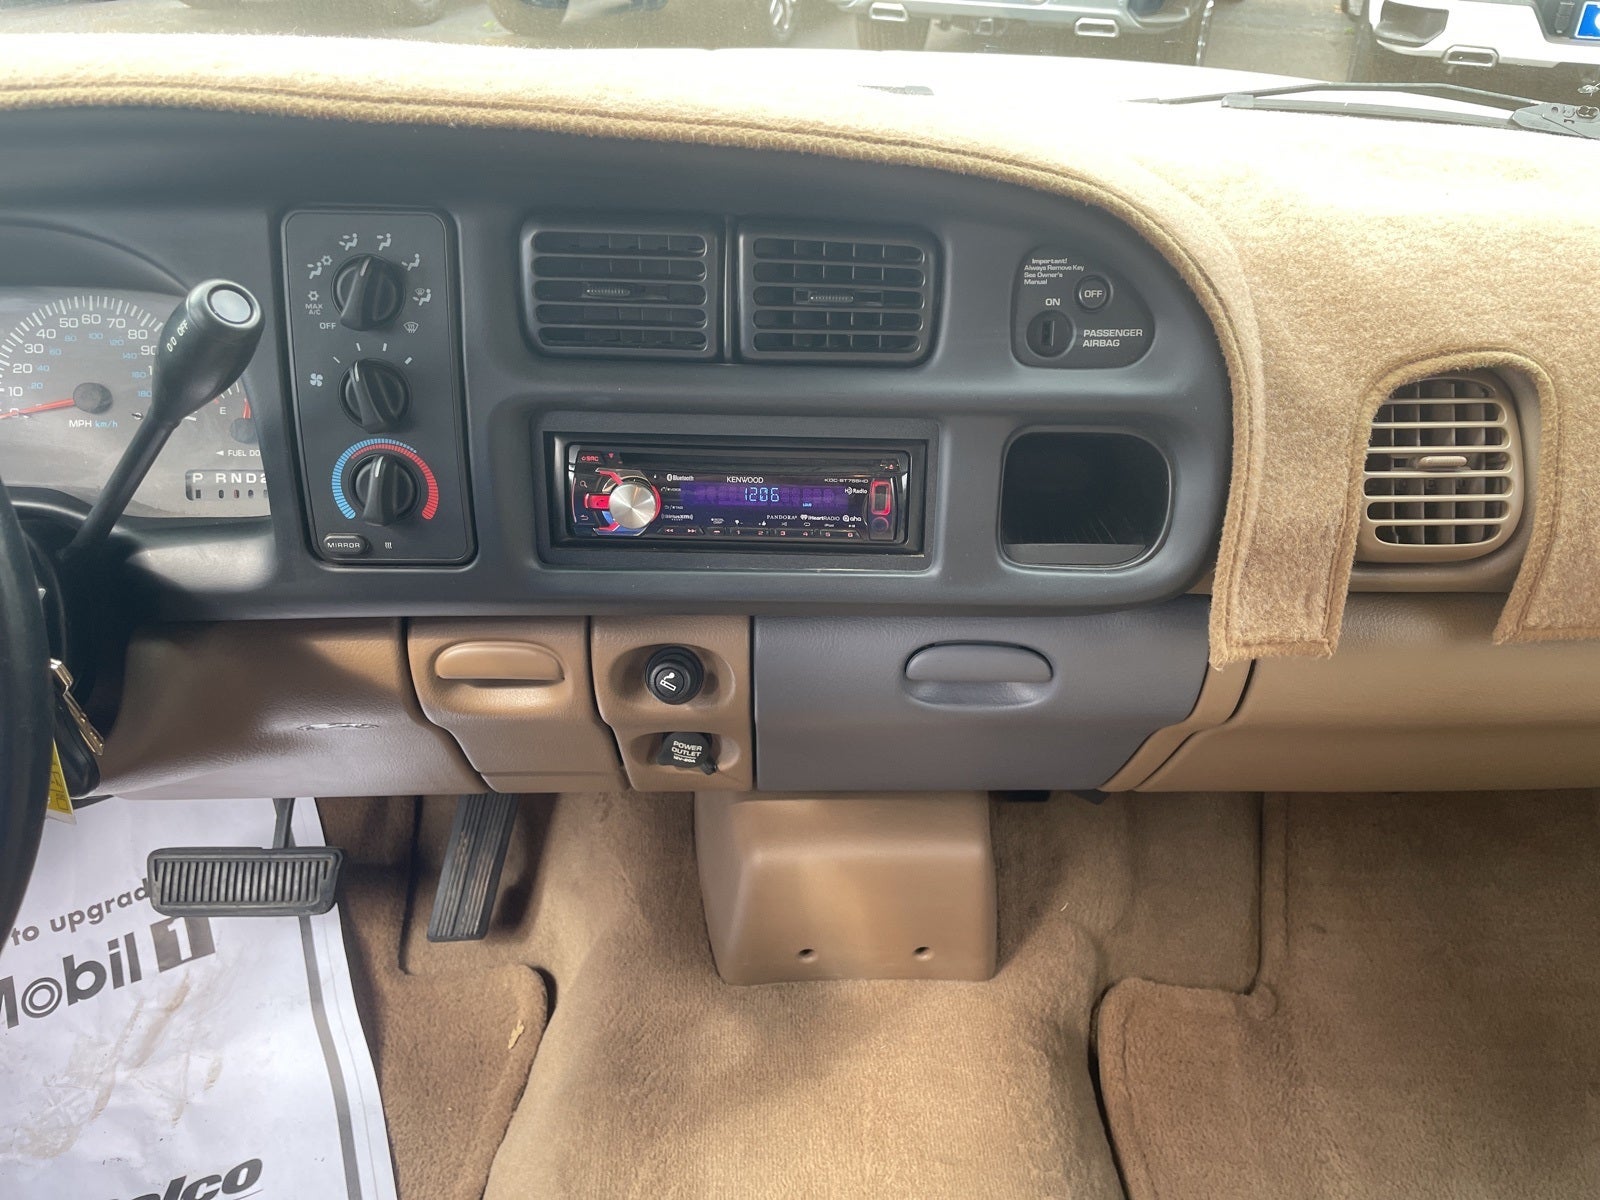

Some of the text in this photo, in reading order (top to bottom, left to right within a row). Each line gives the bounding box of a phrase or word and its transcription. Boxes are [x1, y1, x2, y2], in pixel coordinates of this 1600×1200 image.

[1084, 290, 1103, 298] OFF
[1045, 298, 1061, 306] ON
[59, 318, 78, 328] 50
[81, 314, 101, 324] 60
[107, 318, 126, 328] 70
[177, 320, 189, 337] OFF
[319, 322, 336, 330] OFF
[36, 329, 56, 339] 40
[127, 330, 148, 340] 80
[1083, 329, 1143, 337] PASSENGER
[1083, 339, 1120, 347] AIRBAG
[24, 344, 44, 353] 30
[12, 363, 32, 374] 20
[8, 387, 23, 397] 10
[219, 407, 226, 415] E
[69, 419, 118, 428] MPH km/h
[192, 473, 203, 483] P
[215, 473, 227, 483] R
[231, 473, 242, 483] N
[245, 473, 257, 483] D
[726, 476, 764, 484] KENWOOD
[852, 487, 868, 495] Radio
[327, 542, 361, 550] MIRROR
[673, 740, 703, 752] POWER
[671, 746, 702, 757] OUTLET
[11, 877, 150, 946] to upgrad
